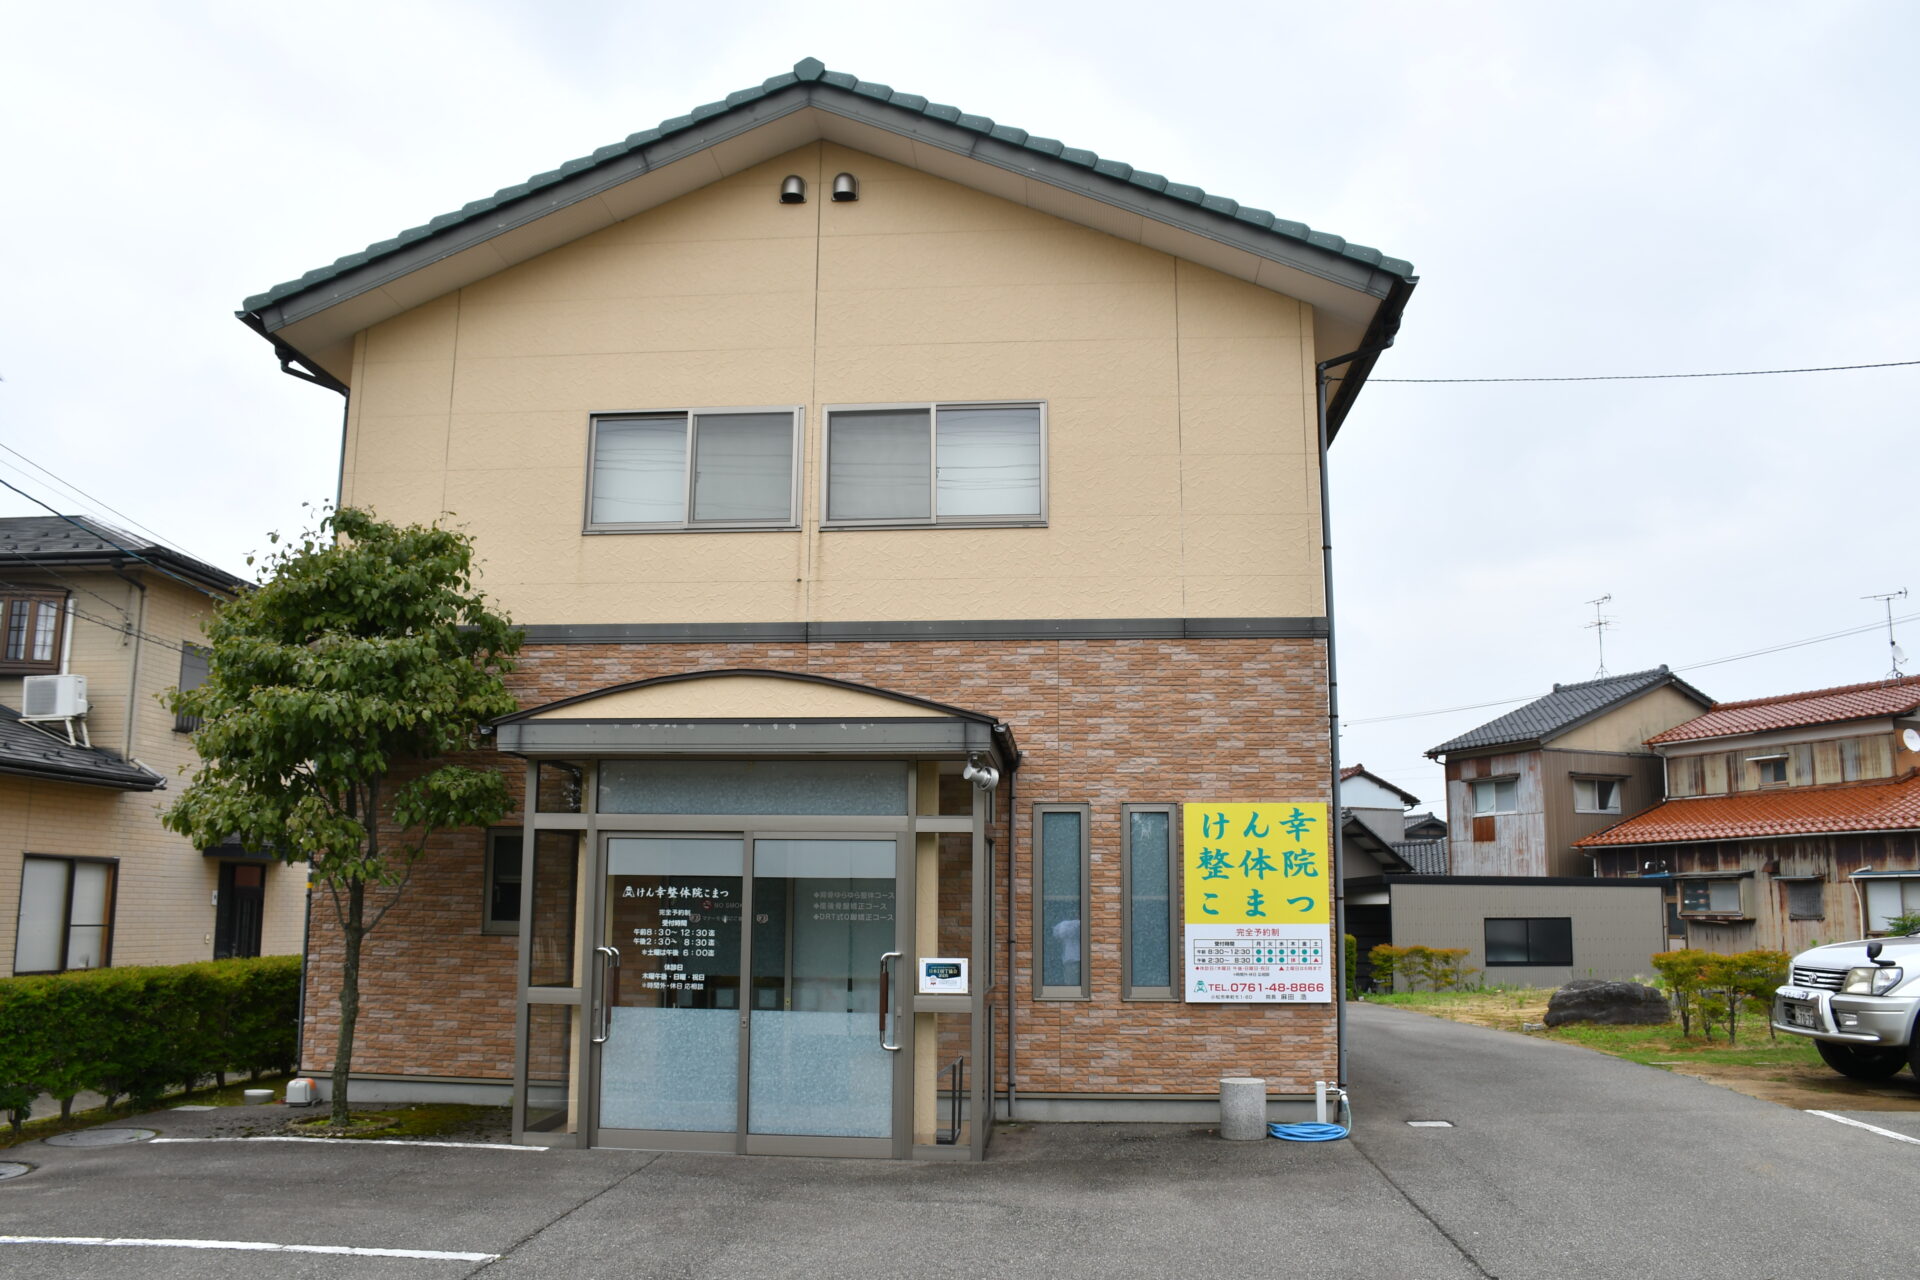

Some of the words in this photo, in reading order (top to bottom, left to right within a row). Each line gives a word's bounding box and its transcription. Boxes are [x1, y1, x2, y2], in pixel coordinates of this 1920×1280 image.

[1202, 807, 1317, 842] けん幸
[1196, 847, 1319, 880] 整体院
[636, 886, 729, 898] けん幸整体院こまつ
[1202, 888, 1315, 917] こまつ
[662, 919, 688, 927] 受付時間
[1236, 928, 1280, 937] 完全予約制
[1230, 983, 1325, 992] 0761-48-8866
